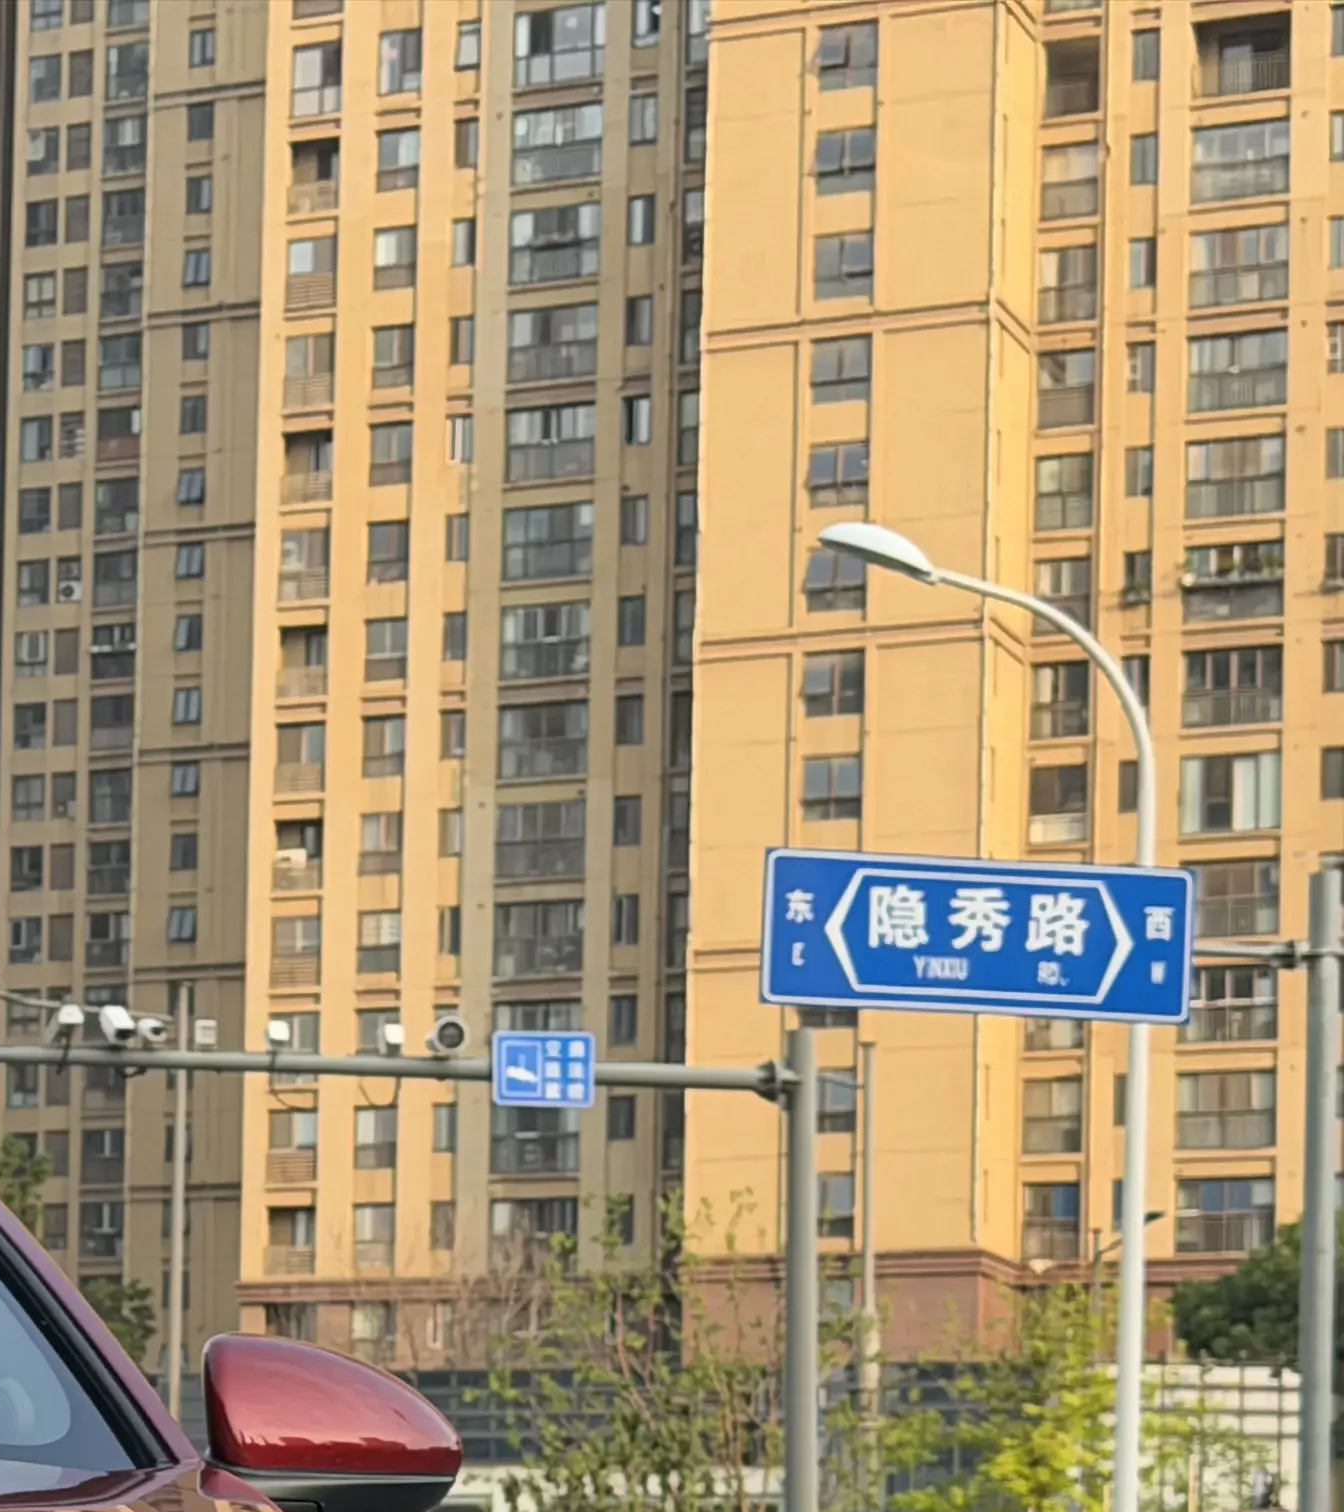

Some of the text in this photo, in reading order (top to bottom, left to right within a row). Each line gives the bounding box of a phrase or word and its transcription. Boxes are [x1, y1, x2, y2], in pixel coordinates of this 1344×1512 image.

[785, 888, 815, 924] 东
[868, 884, 1090, 956] 隐秀路
[1143, 905, 1175, 941] 西
